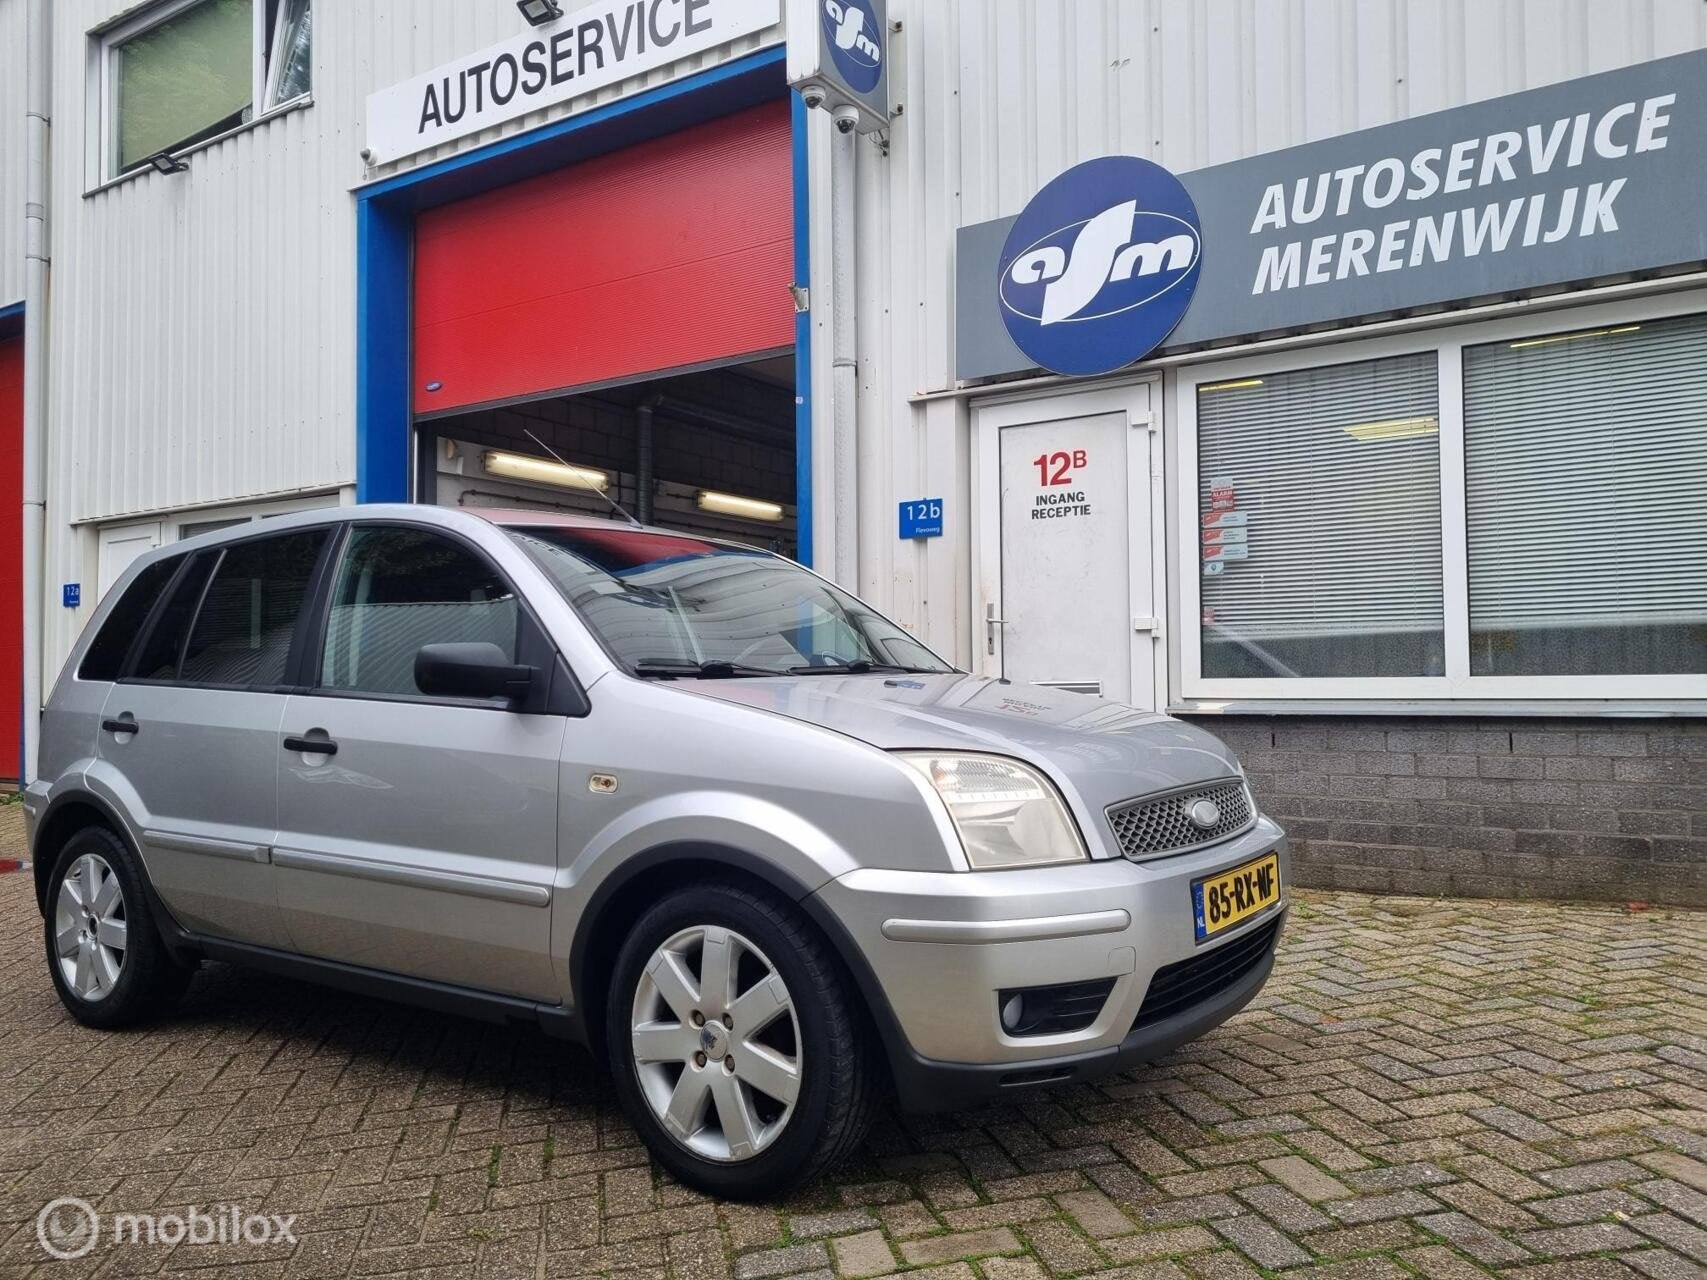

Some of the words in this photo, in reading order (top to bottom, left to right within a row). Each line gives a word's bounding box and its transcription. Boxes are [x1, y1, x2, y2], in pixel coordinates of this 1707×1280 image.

[418, 0, 713, 134] AUTOSERVICE
[1250, 93, 1676, 234] AUTOSERVICE
[1251, 177, 1628, 296] MERENWIJK
[1031, 504, 1091, 520] RECEPTIE
[1035, 491, 1085, 506] INGANG
[1208, 863, 1274, 924] 85-RX-NF
